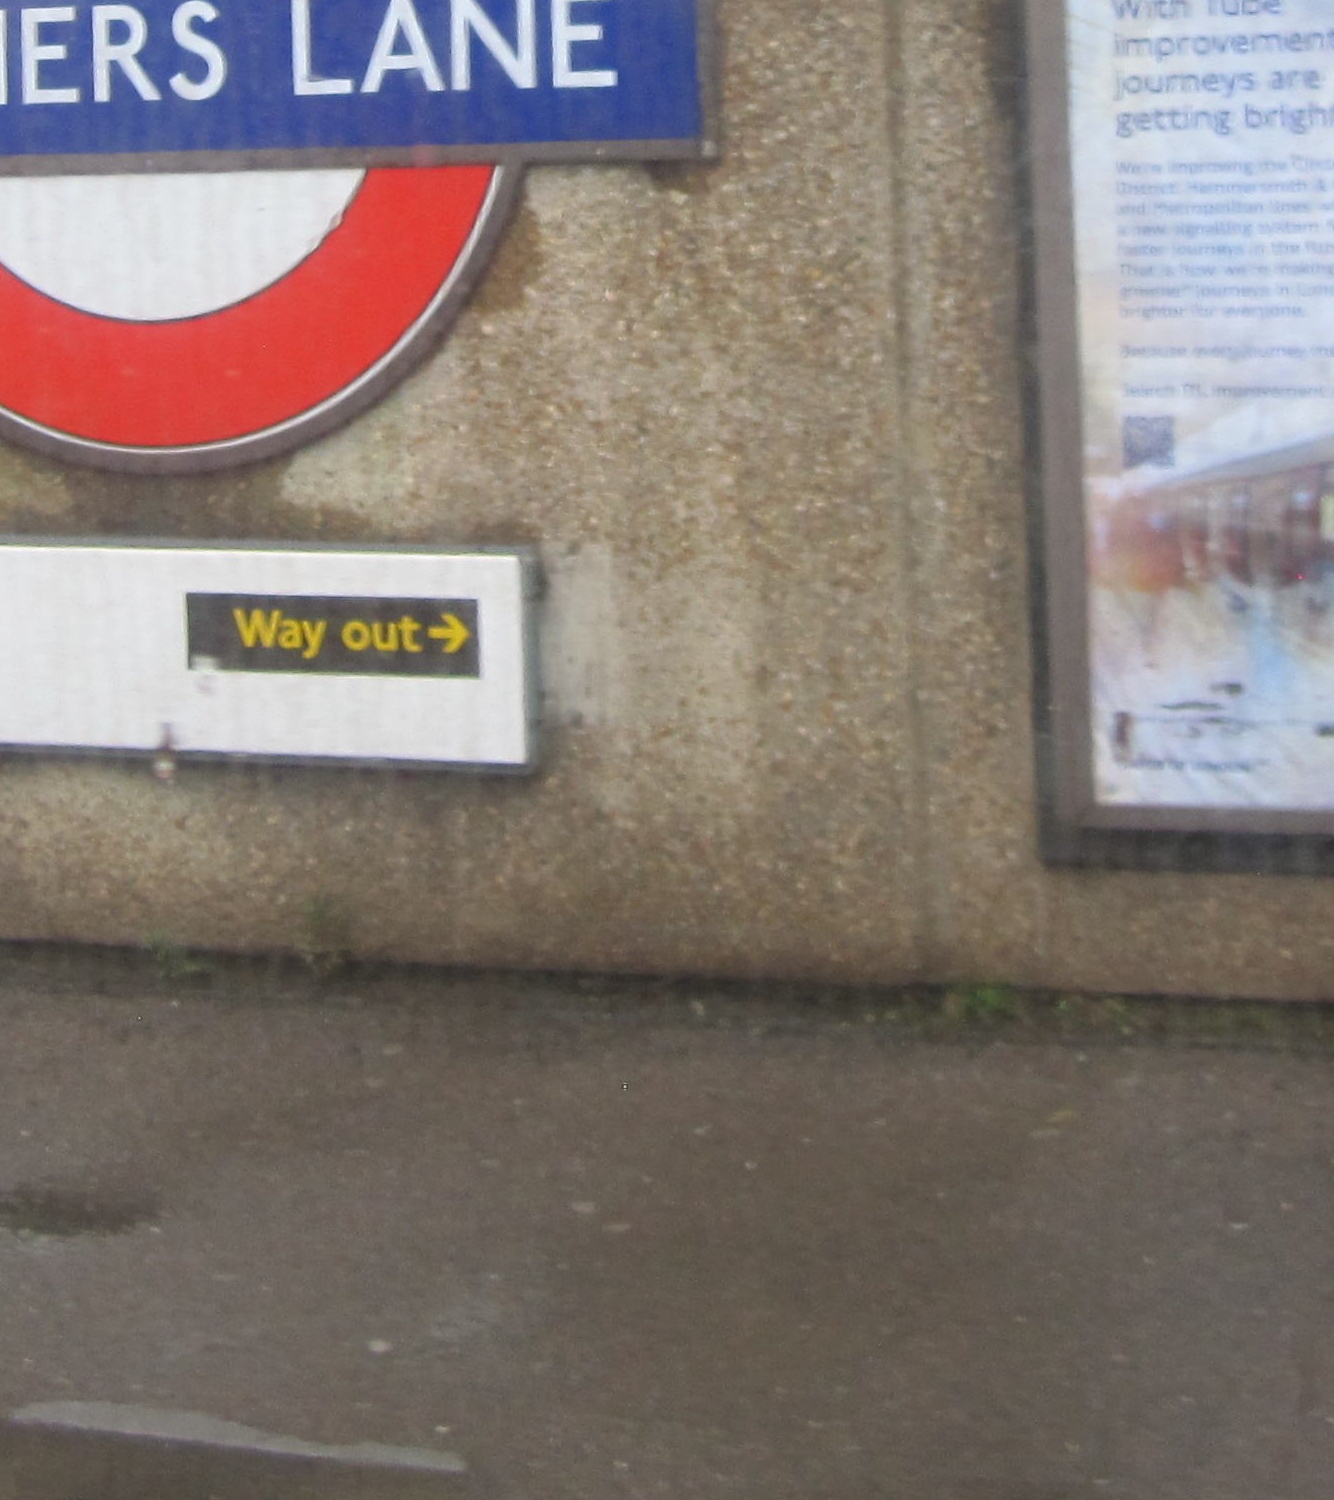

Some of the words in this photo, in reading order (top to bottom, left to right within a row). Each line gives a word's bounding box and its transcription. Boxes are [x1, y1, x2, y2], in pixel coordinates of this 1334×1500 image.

[1114, 69, 1255, 101] journeys
[1268, 69, 1324, 91] are
[1116, 107, 1233, 138] getting
[233, 607, 327, 659] Way
[341, 615, 423, 653] out
